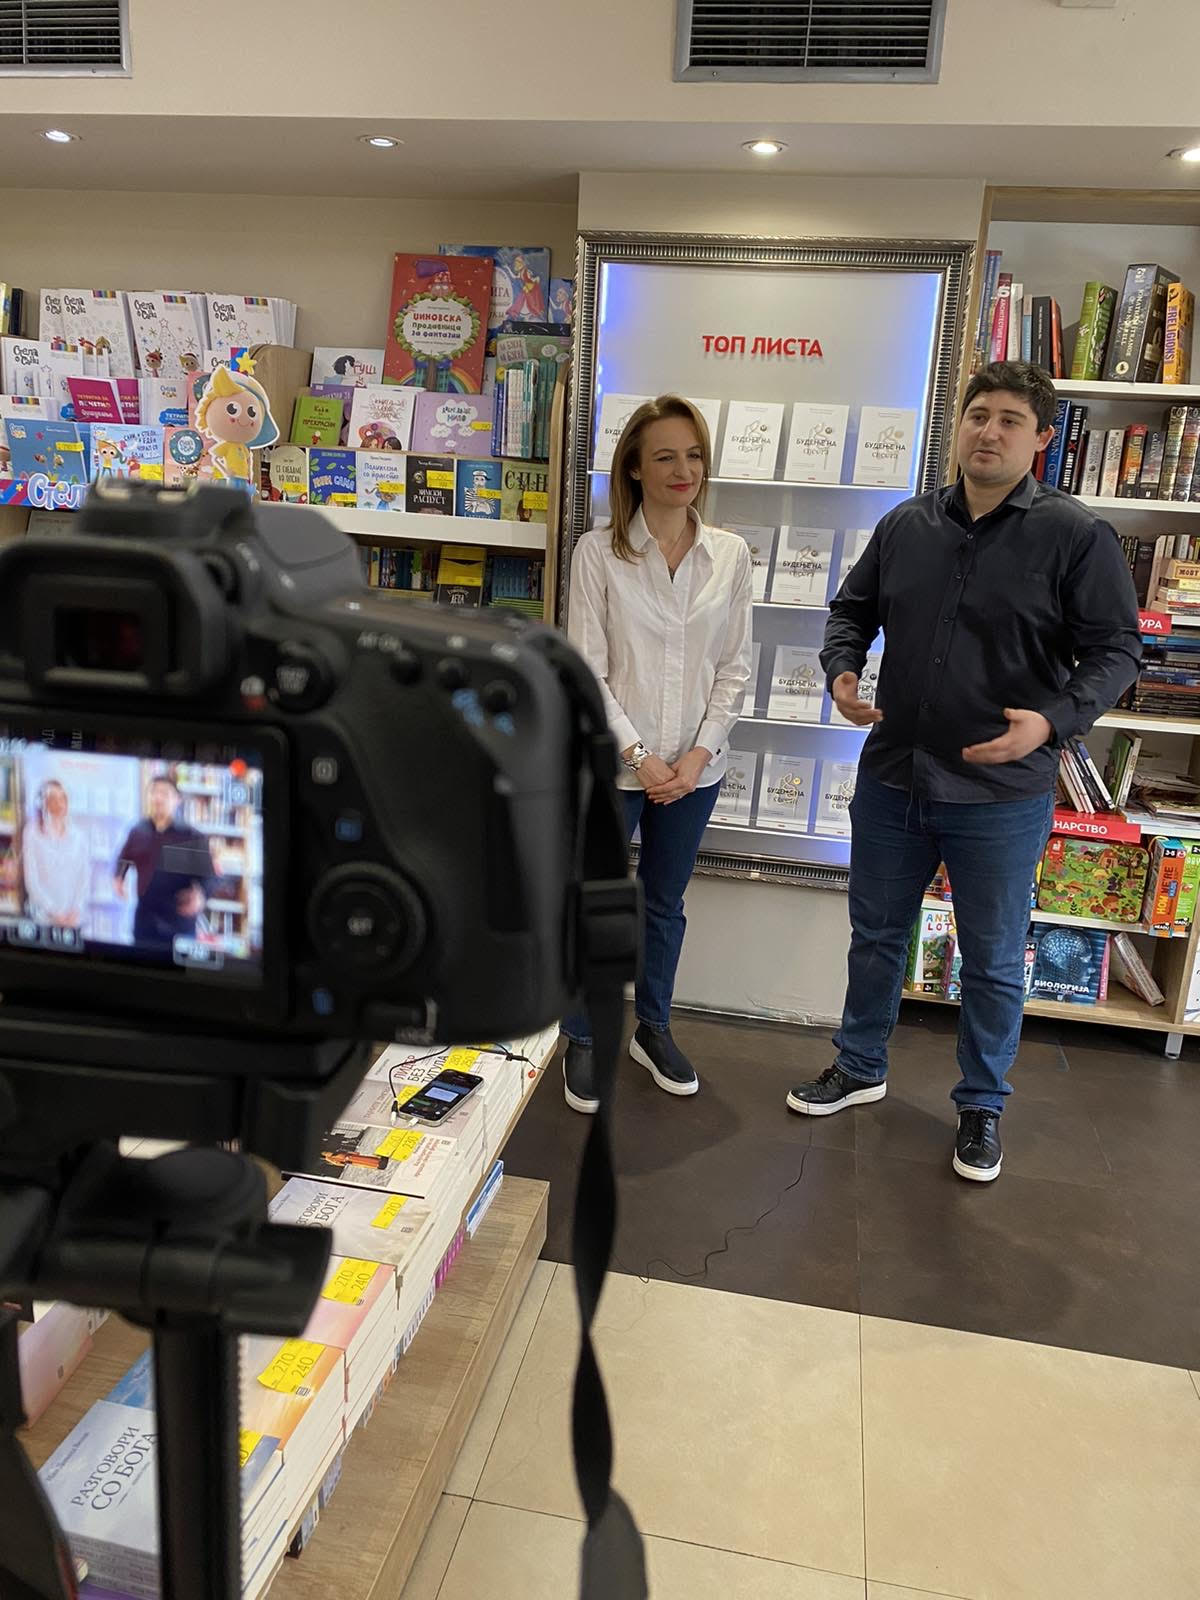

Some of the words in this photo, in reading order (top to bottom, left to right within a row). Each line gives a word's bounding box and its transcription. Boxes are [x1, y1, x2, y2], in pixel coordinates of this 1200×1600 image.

[1165, 309, 1179, 361] RELIGIONS
[702, 335, 746, 353] ТОП
[751, 337, 824, 357] ЛИСТА
[1055, 402, 1066, 422] DAN
[1070, 422, 1080, 440] STORM
[864, 441, 895, 450] БУДЕЊЕ
[895, 443, 906, 451] НА
[782, 560, 813, 569] БУДЕЊЕ
[778, 678, 808, 687] БУДЕЊЕ
[1161, 866, 1174, 893] WE'RE
[1156, 895, 1168, 915] HOW
[1034, 979, 1090, 993] БИОЛОГИЈА
[407, 1067, 426, 1082] БЕЗ
[334, 1270, 354, 1287] 270
[351, 1272, 372, 1291] 240
[272, 1352, 296, 1373] 270
[291, 1356, 314, 1379] 240
[70, 1426, 140, 1507] РАЗГОВОРИ
[91, 1480, 122, 1510] СО
[113, 1432, 159, 1478] БОГА
